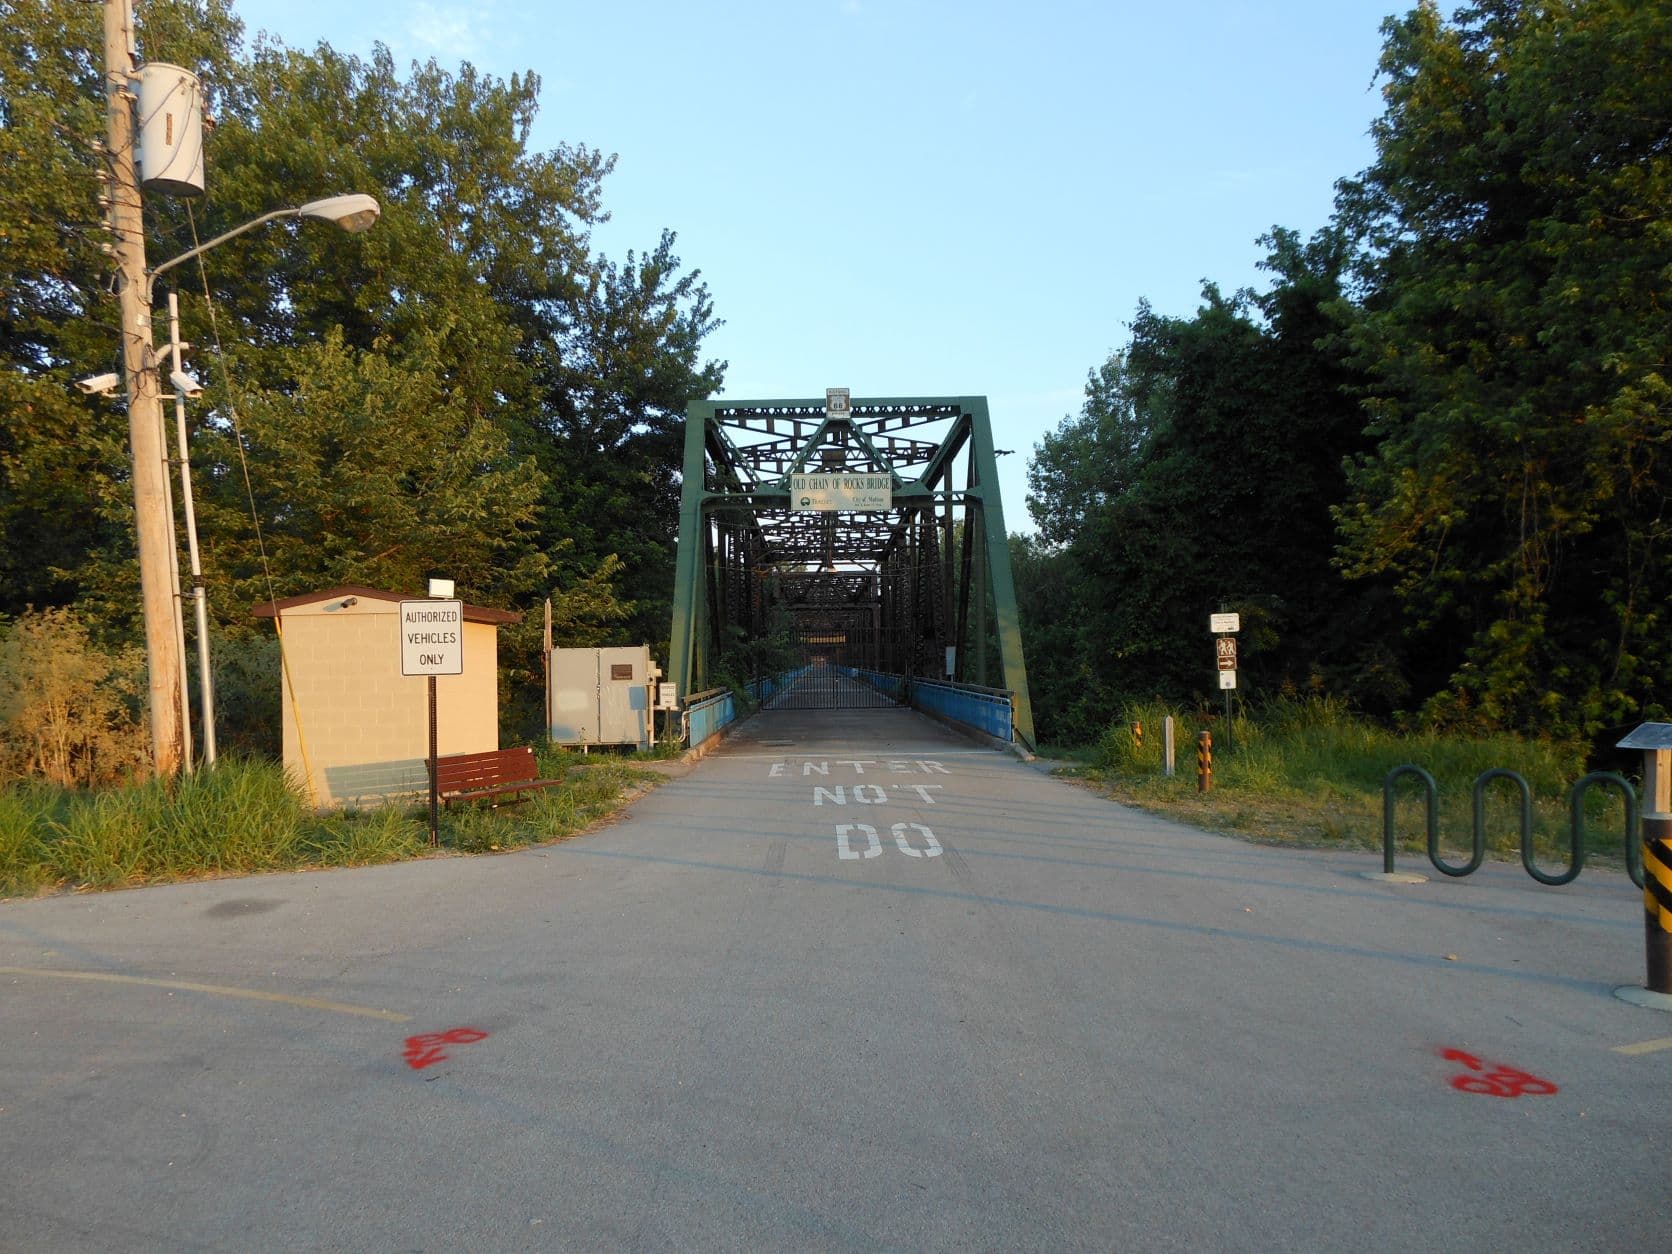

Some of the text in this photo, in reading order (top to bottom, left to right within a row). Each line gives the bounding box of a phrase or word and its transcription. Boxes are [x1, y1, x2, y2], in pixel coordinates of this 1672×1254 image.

[793, 477, 890, 490] OLD CHAIN OF ROCKS BRIDGE
[405, 611, 457, 623] AUTHORIZED
[407, 632, 456, 644] VEHICLES
[419, 653, 444, 665] ONLY
[768, 760, 952, 778] ENTER
[813, 784, 944, 806] NOT
[835, 822, 944, 860] DO
